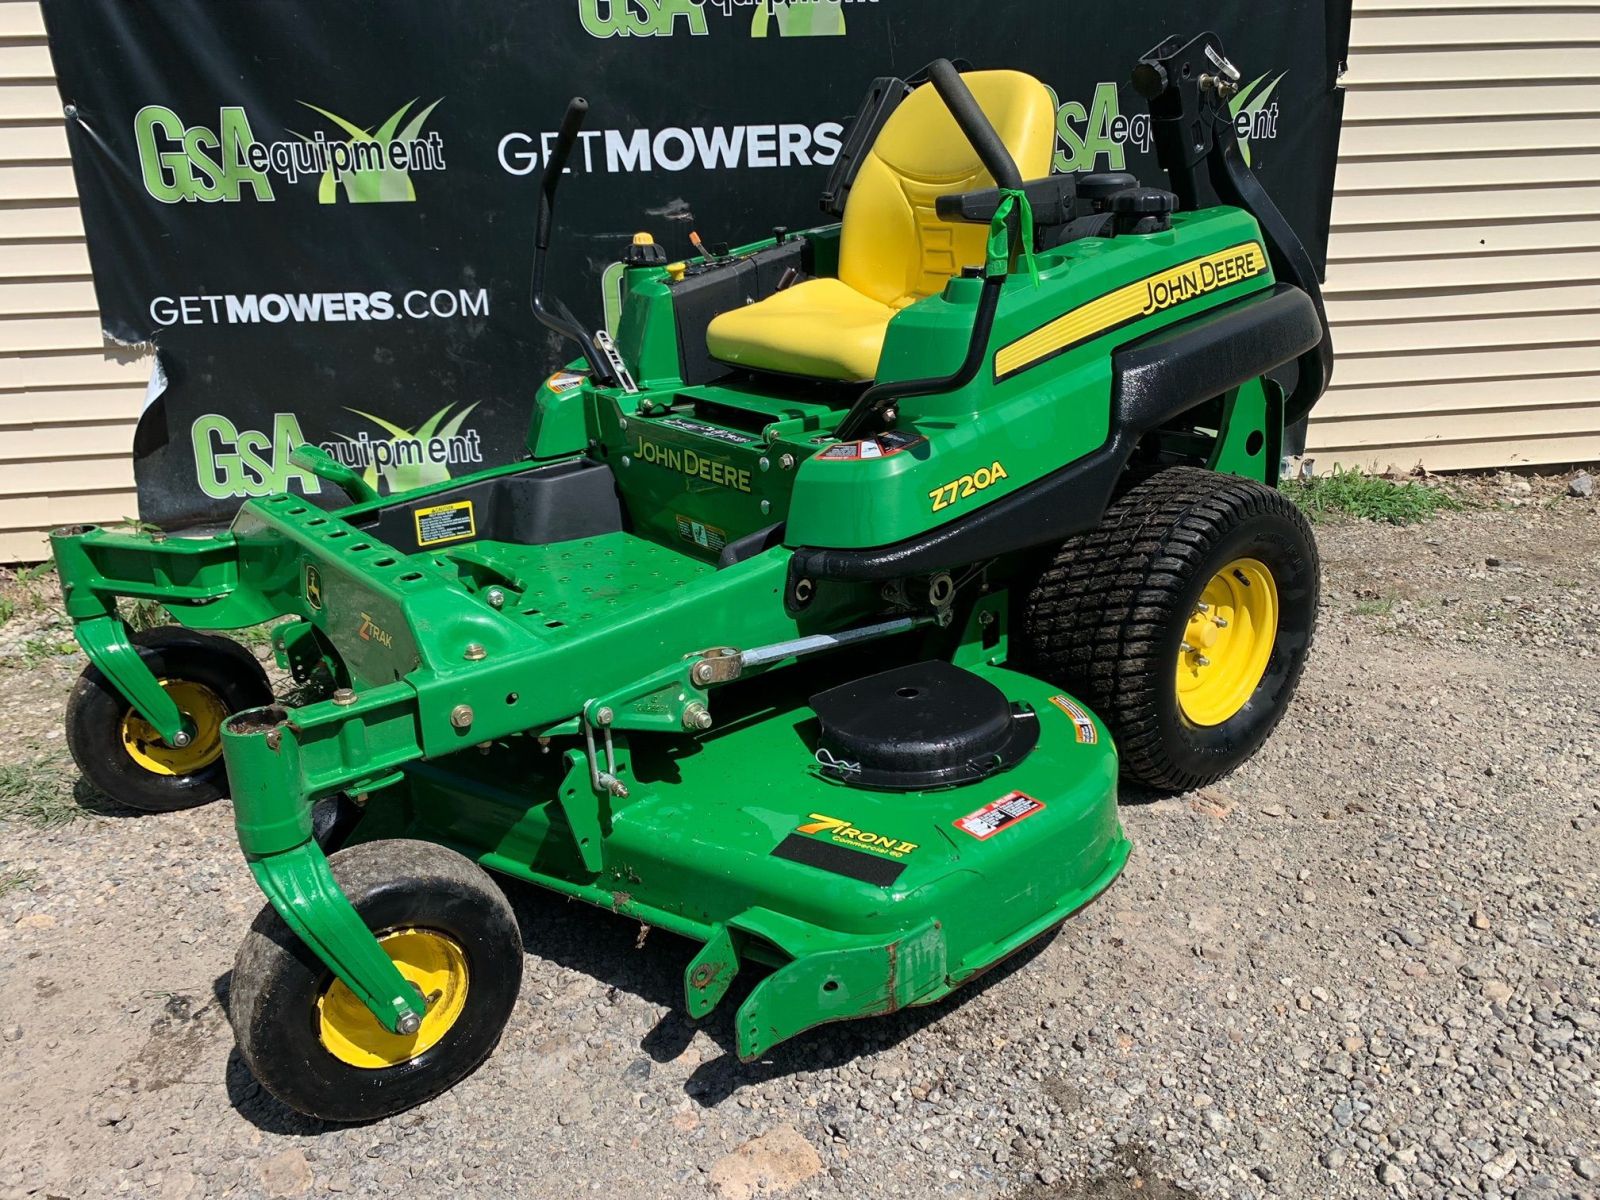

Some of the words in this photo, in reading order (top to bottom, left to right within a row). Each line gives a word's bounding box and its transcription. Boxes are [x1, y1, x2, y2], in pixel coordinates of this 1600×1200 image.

[248, 131, 446, 184] equipment
[149, 288, 490, 326] GETMOWERS.COM
[1143, 270, 1199, 312] JOHN
[1198, 251, 1256, 289] DEERE
[633, 435, 682, 472] JOHN
[683, 448, 751, 493] DEERE
[928, 461, 1008, 513] Z720A
[831, 835, 889, 855] Commercial
